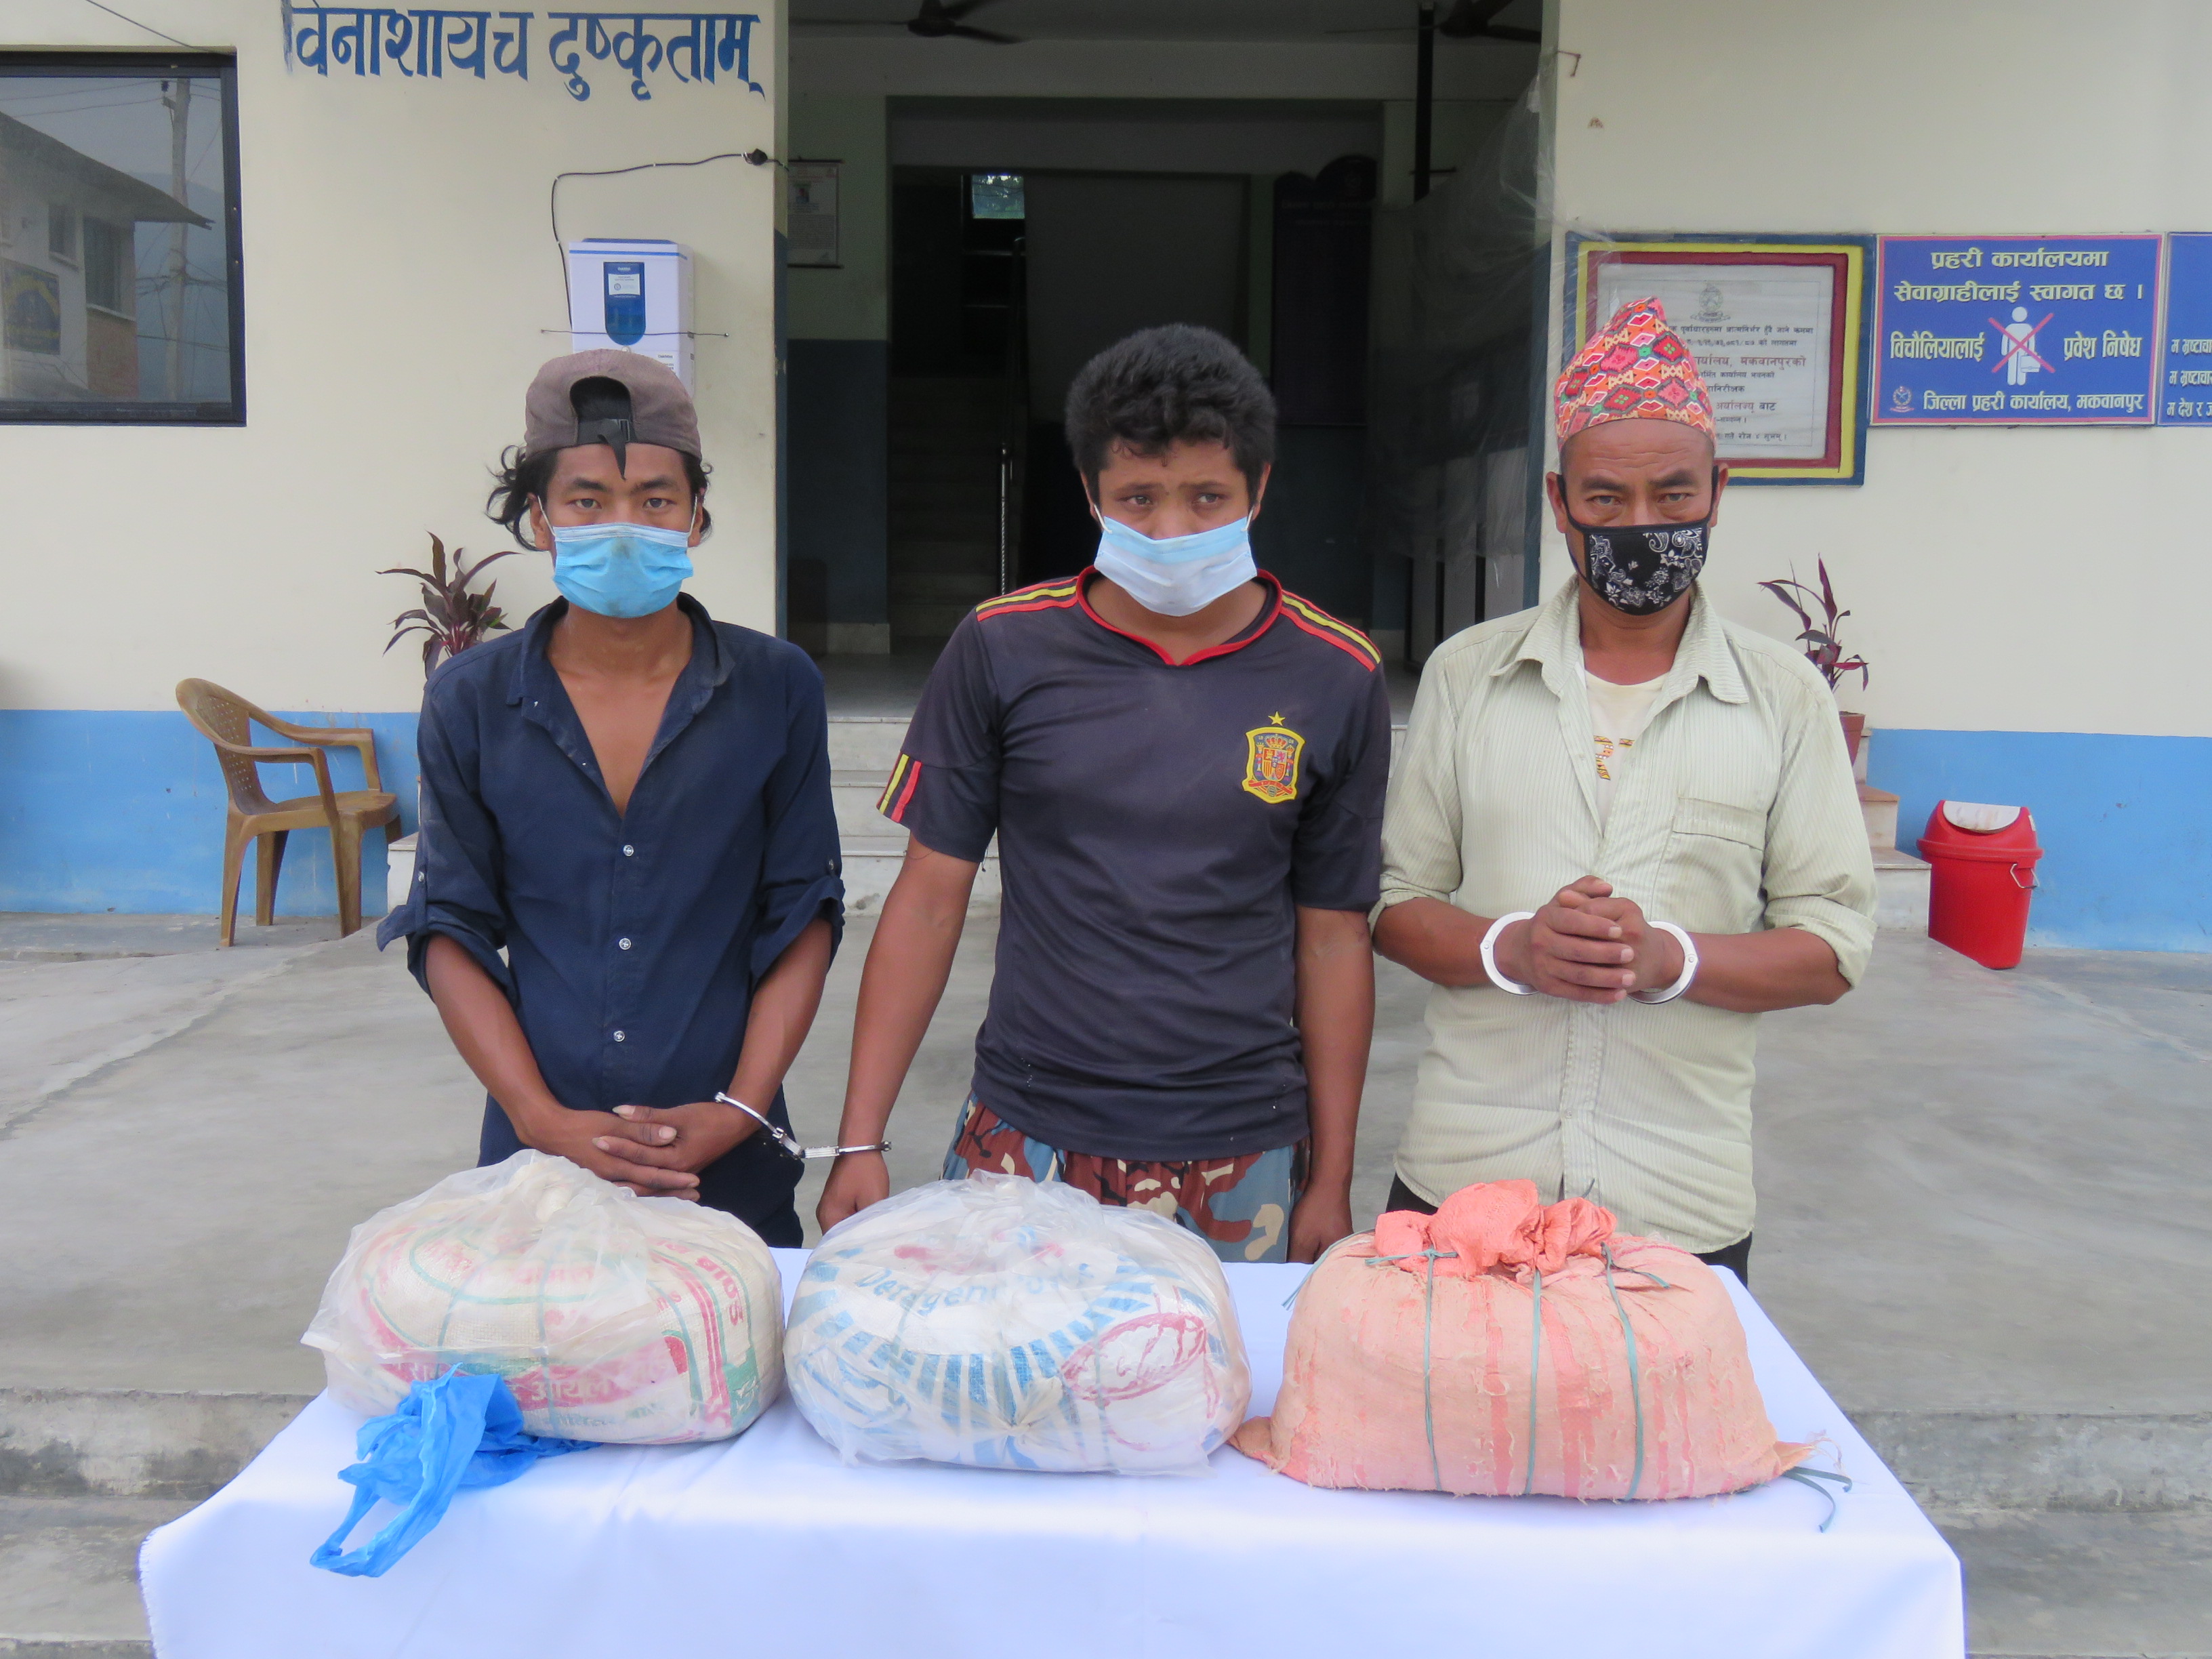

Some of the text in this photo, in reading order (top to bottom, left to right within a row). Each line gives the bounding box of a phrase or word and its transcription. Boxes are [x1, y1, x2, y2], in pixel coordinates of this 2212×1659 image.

[547, 12, 766, 102] दुष्कृताम्
[1930, 247, 2110, 270] प्रहरी कार्यालयमा
[1893, 279, 2022, 303] सेवाग्राहीलाई
[2029, 283, 2096, 301] स्वागत
[2104, 283, 2126, 300] छ
[2062, 331, 2098, 361] प्रवेश
[2102, 329, 2143, 359] निषेध
[2171, 339, 2179, 353] म
[1740, 355, 1806, 370] मकवानपुरको
[2169, 371, 2178, 385] म
[1923, 390, 2145, 413] जिल्ला प्रहरी कार्यालय, मकवानपुर
[2167, 402, 2175, 416] म
[2178, 397, 2194, 417] देश
[2196, 402, 2204, 416] र
